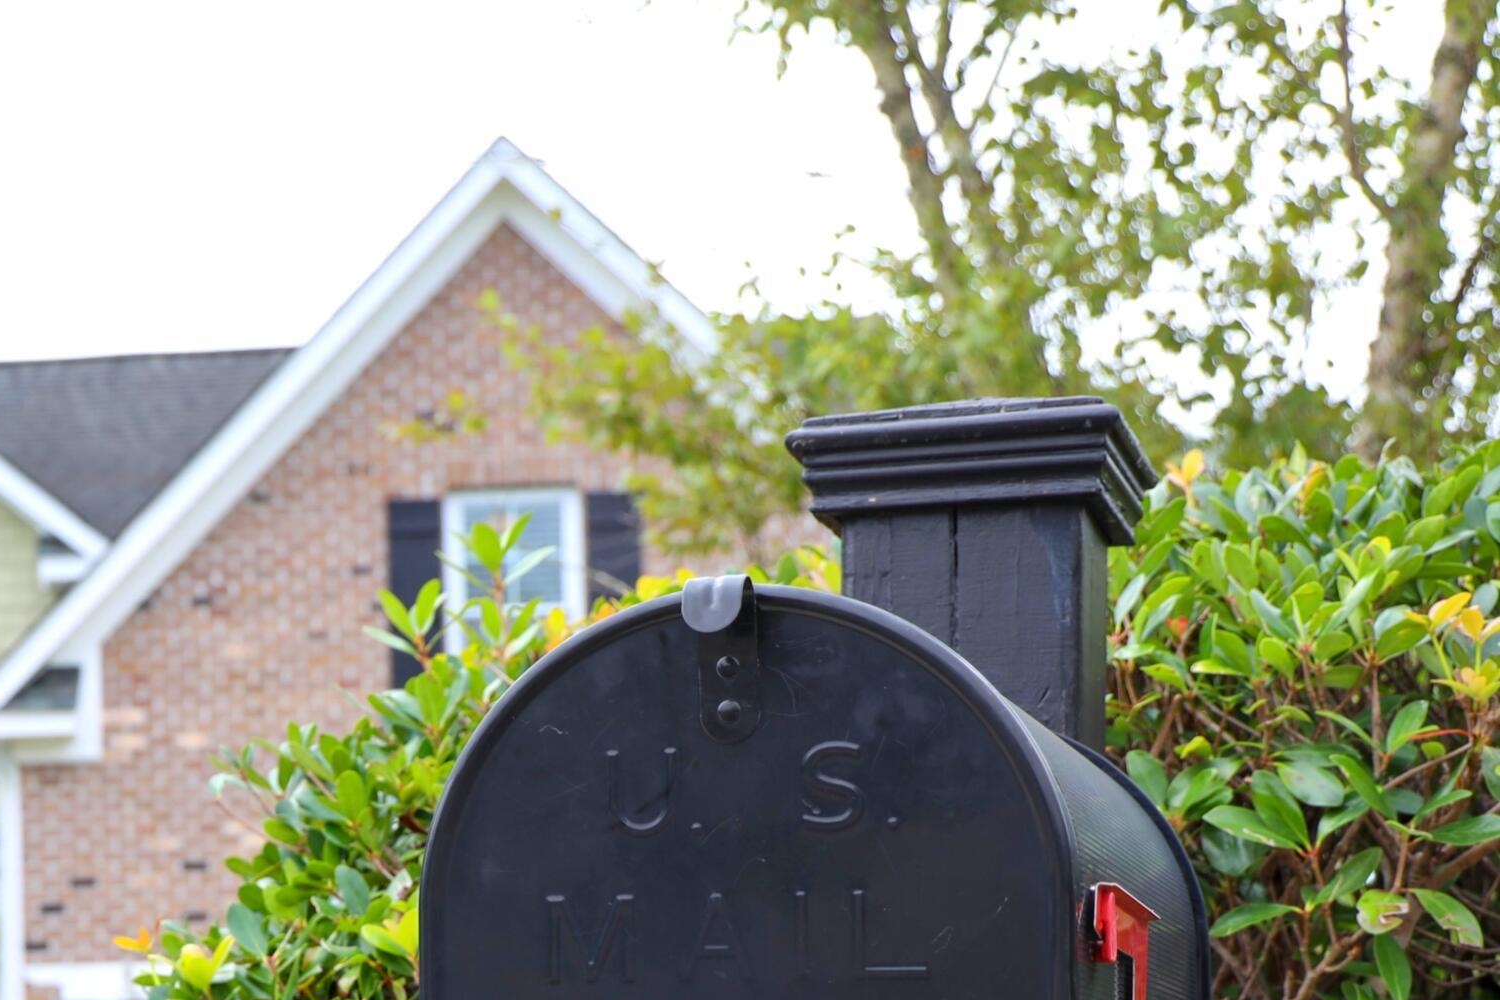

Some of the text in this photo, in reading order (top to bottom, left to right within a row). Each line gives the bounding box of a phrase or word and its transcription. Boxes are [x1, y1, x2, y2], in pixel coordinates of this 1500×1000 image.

[605, 739, 900, 836] U. S.
[543, 887, 929, 985] MAIL
